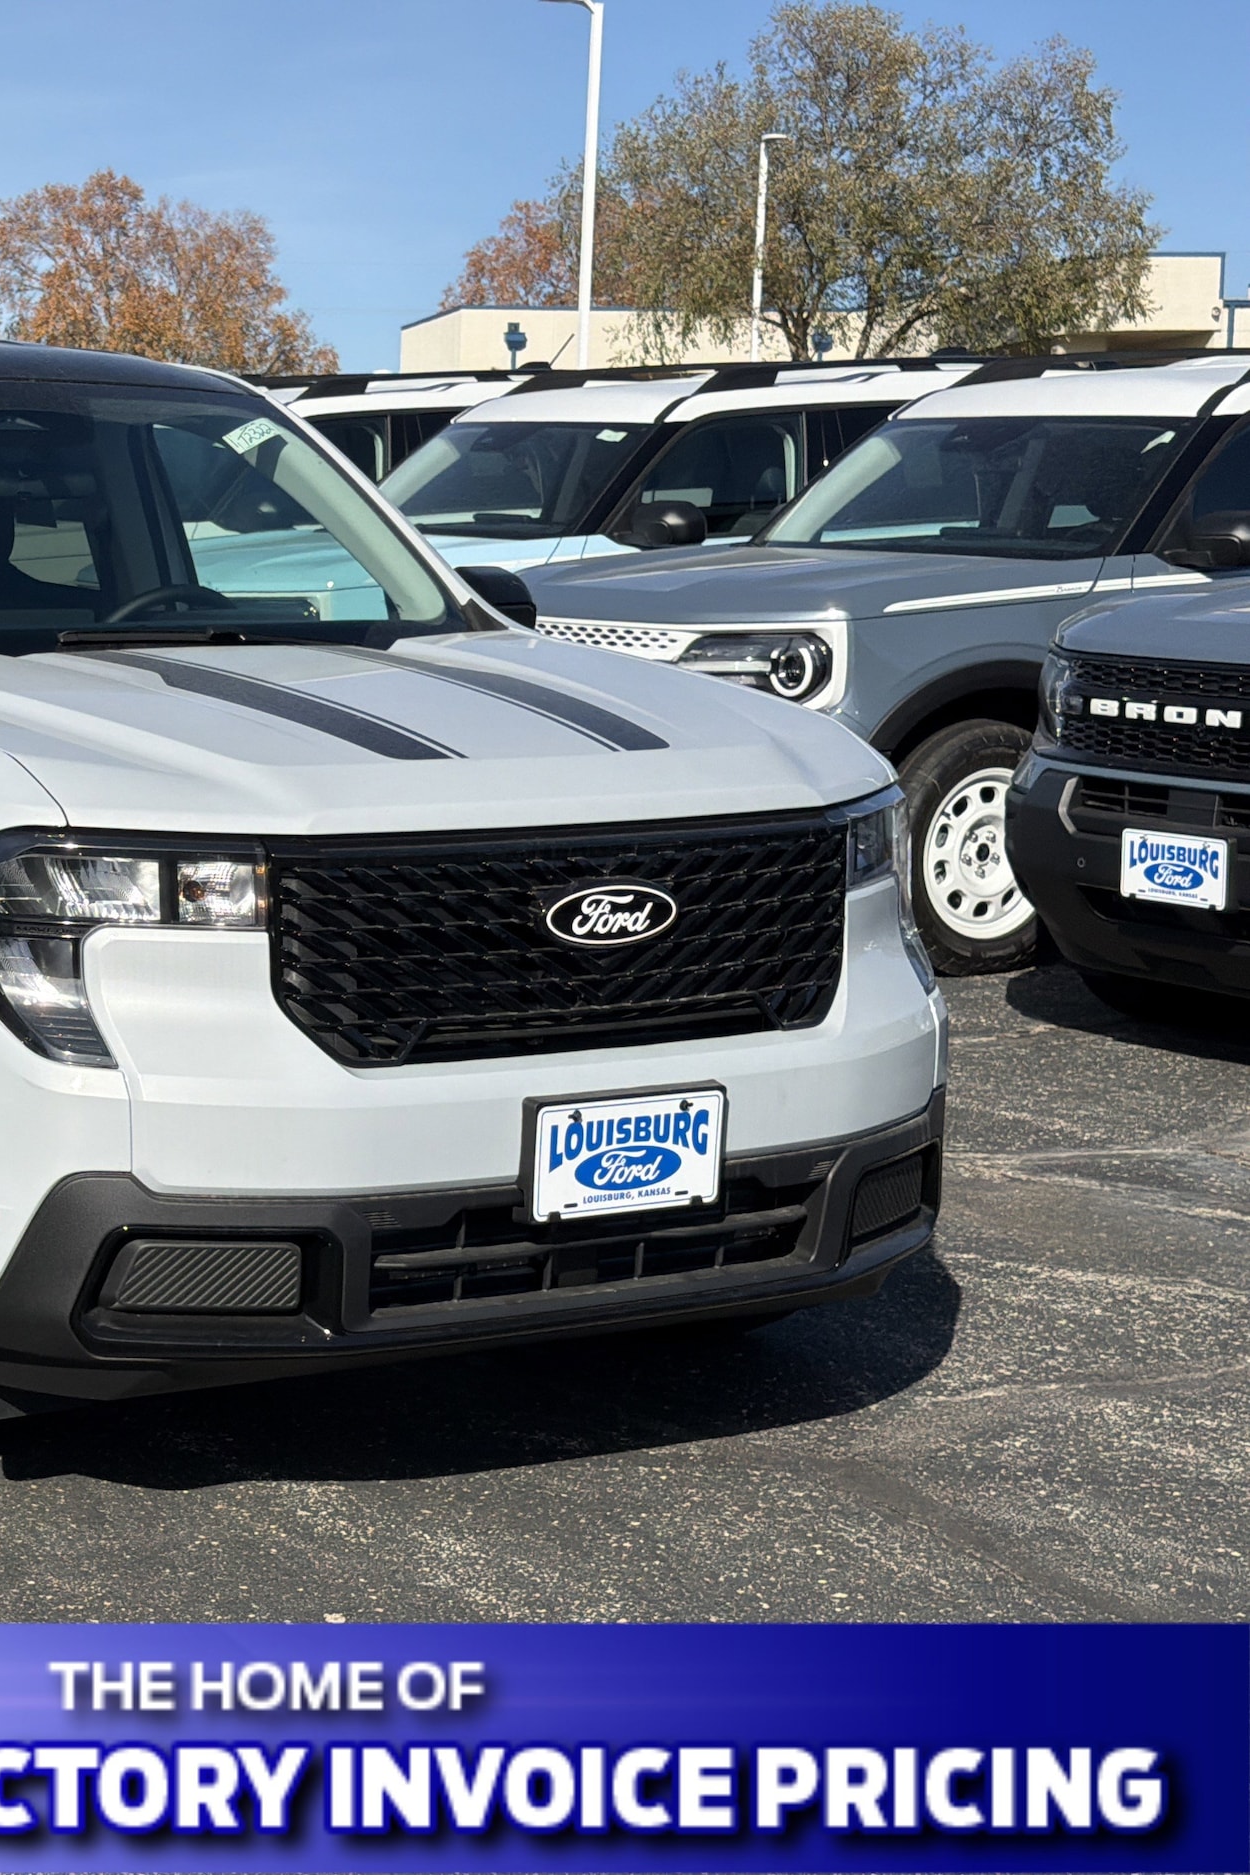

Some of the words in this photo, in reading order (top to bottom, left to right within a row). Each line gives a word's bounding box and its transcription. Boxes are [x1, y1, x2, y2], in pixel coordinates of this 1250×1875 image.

[1129, 840, 1219, 880] LOUISBURG
[1154, 864, 1193, 888] Ford
[571, 894, 654, 936] Ford
[548, 1108, 710, 1174] LOUISBURG
[592, 1149, 664, 1187] Ford
[582, 1190, 636, 1205] LOUISBURG,
[637, 1186, 671, 1199] KANSAS
